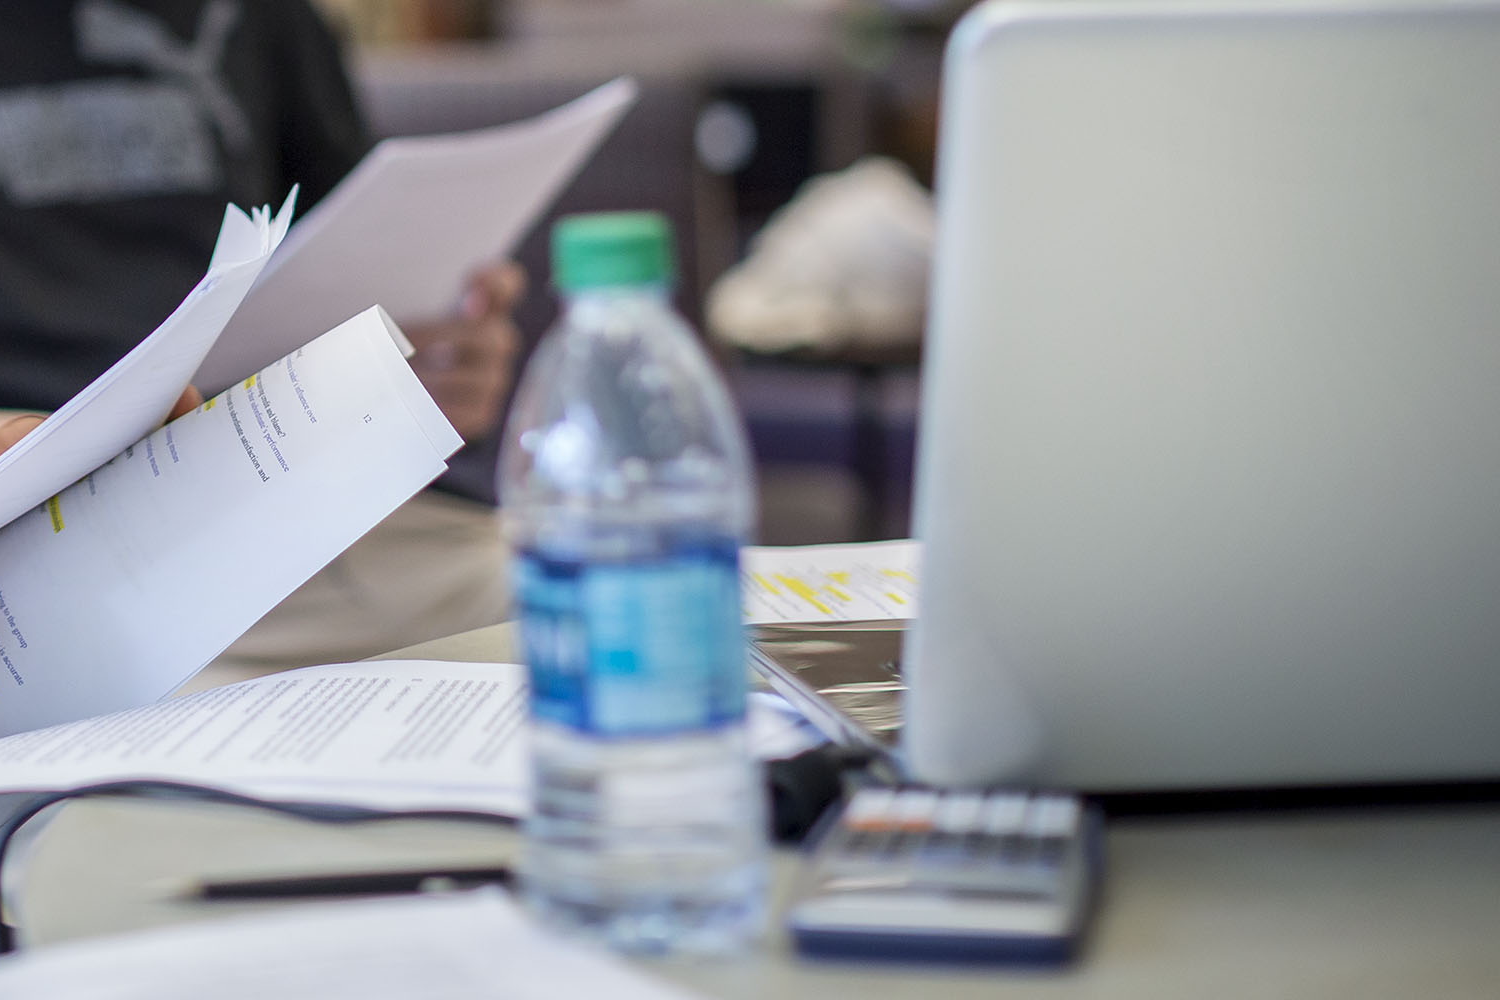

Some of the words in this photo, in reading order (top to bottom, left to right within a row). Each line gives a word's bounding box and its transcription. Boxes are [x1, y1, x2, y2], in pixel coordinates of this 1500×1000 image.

[270, 415, 286, 439] blame?
[305, 409, 317, 424] over
[239, 434, 261, 470] satisfaction
[257, 468, 270, 483] and
[262, 432, 290, 473] performance
[6, 614, 16, 628] the
[10, 627, 28, 649] group
[2, 655, 24, 686] accurate
